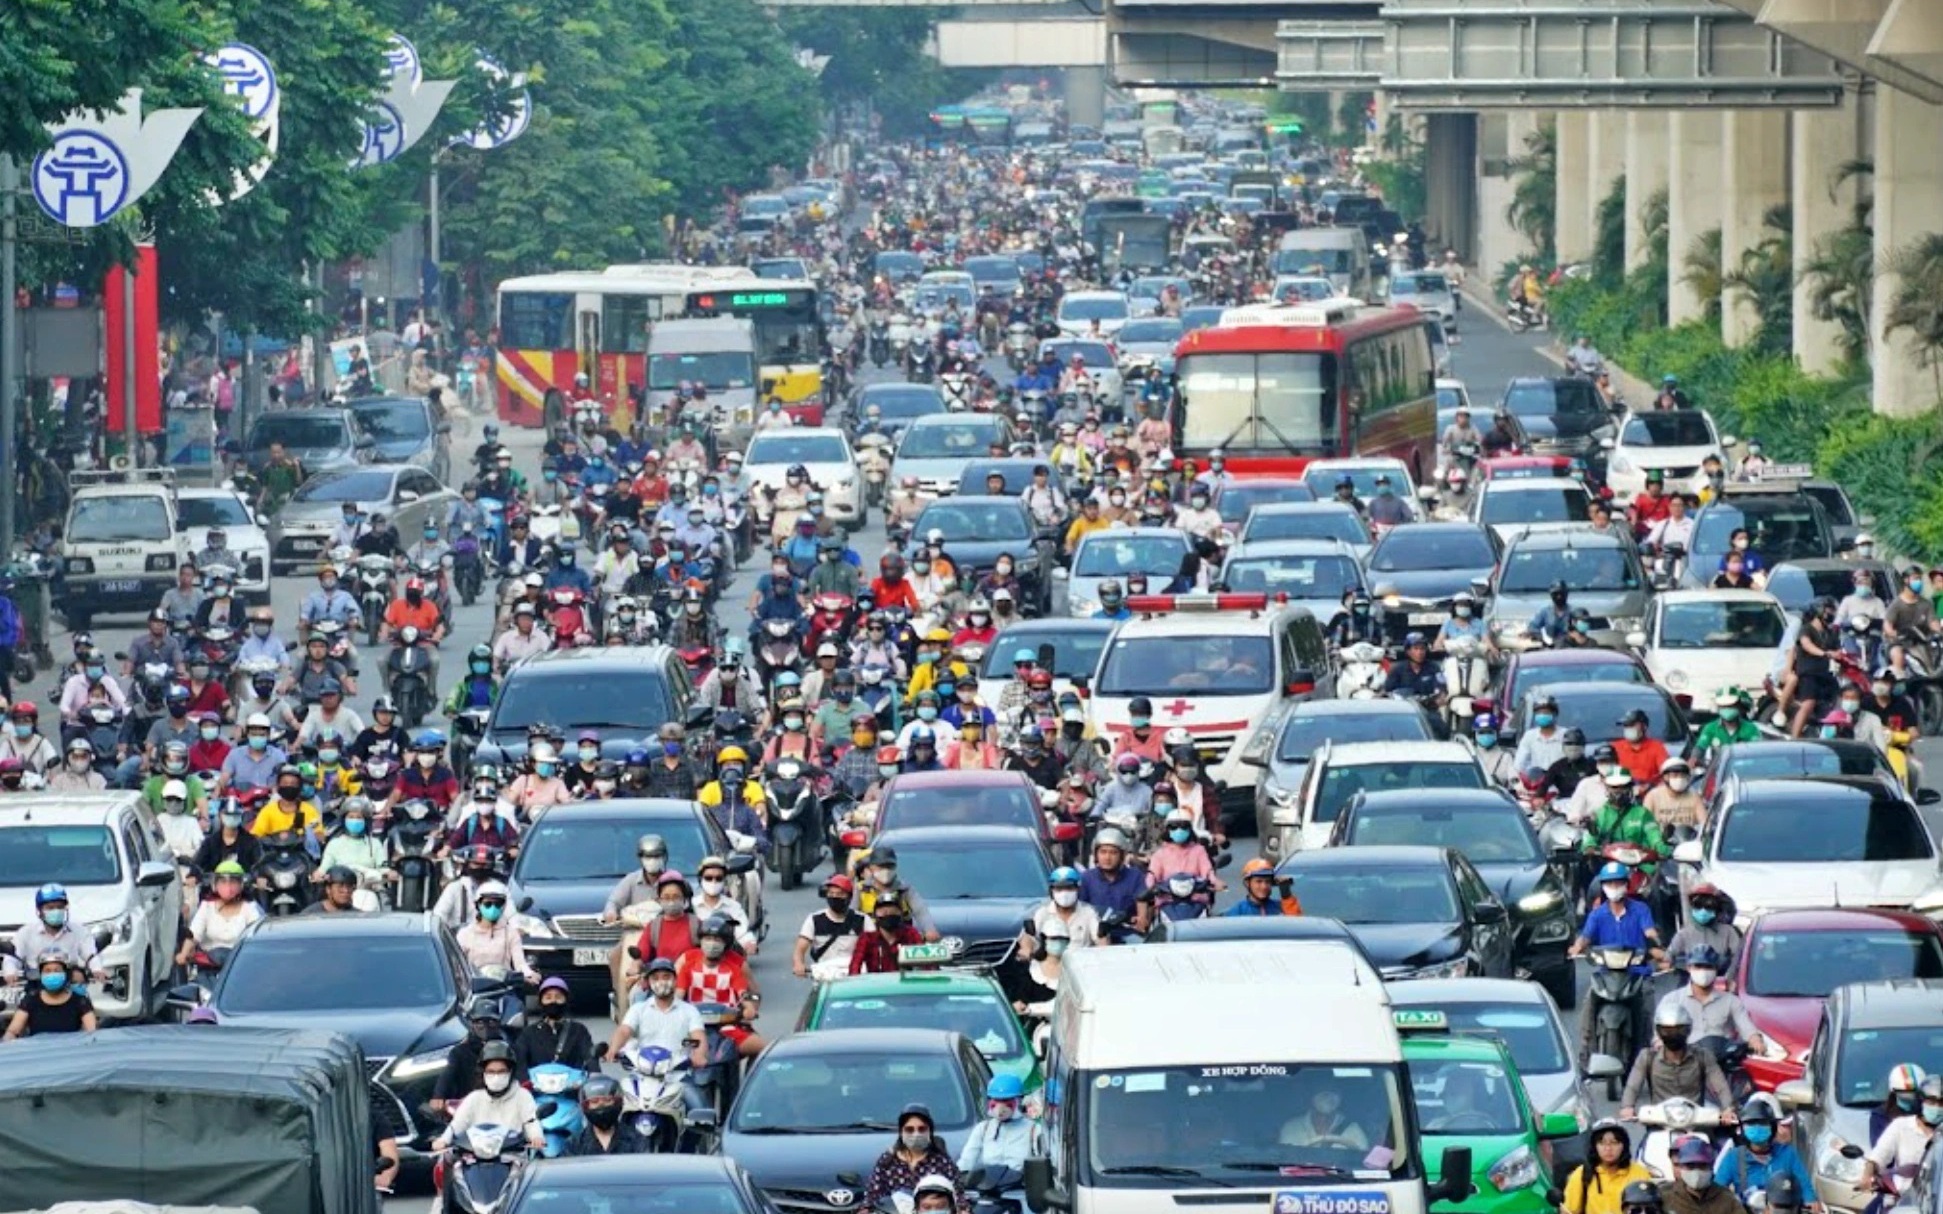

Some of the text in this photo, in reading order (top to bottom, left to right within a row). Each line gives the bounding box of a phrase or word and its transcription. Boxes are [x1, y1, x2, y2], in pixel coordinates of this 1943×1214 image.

[98, 547, 142, 556] SUZUKI
[905, 946, 946, 959] TAXI
[1397, 1011, 1439, 1023] TAXI
[1202, 1068, 1220, 1077] XE
[1360, 1199, 1388, 1214] SAO
